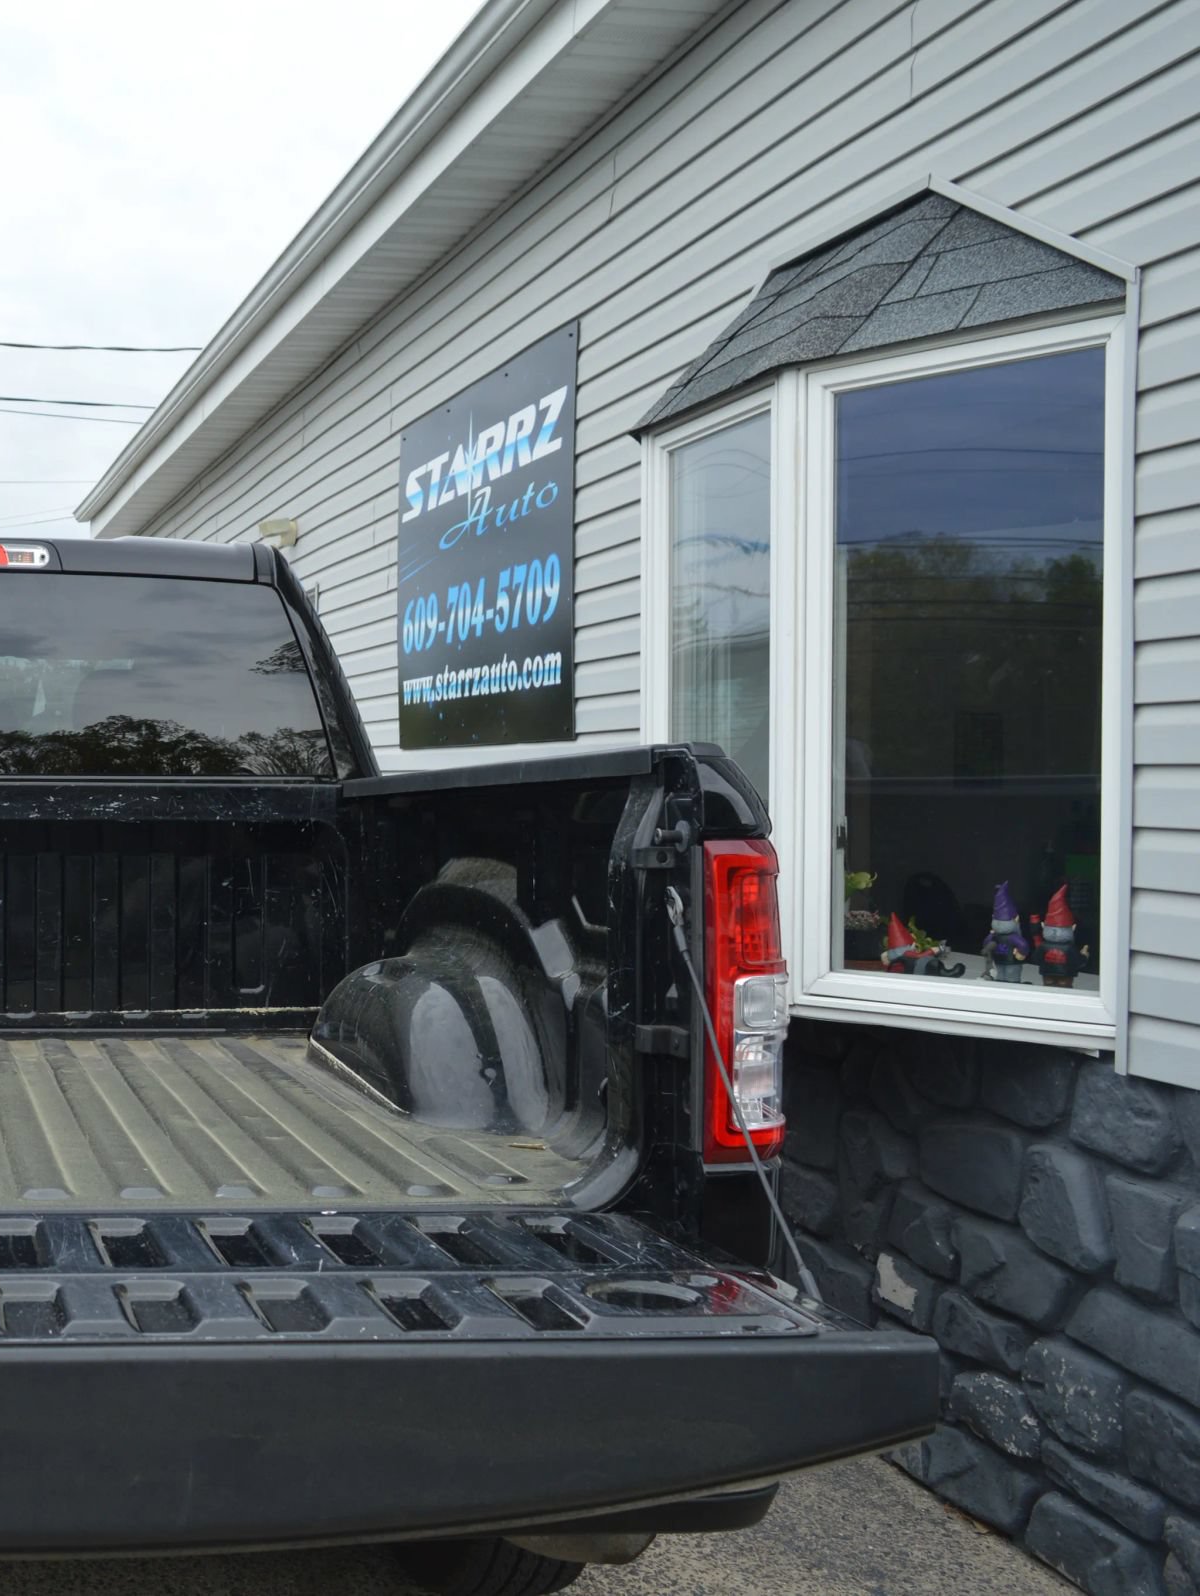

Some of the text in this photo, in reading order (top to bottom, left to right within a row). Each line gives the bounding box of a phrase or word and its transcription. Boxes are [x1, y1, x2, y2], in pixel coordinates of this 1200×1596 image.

[402, 385, 568, 523] STARRZ
[439, 481, 558, 550] Auto
[403, 553, 561, 655] 609-704-5709
[403, 651, 563, 705] www.starrzauto.com
